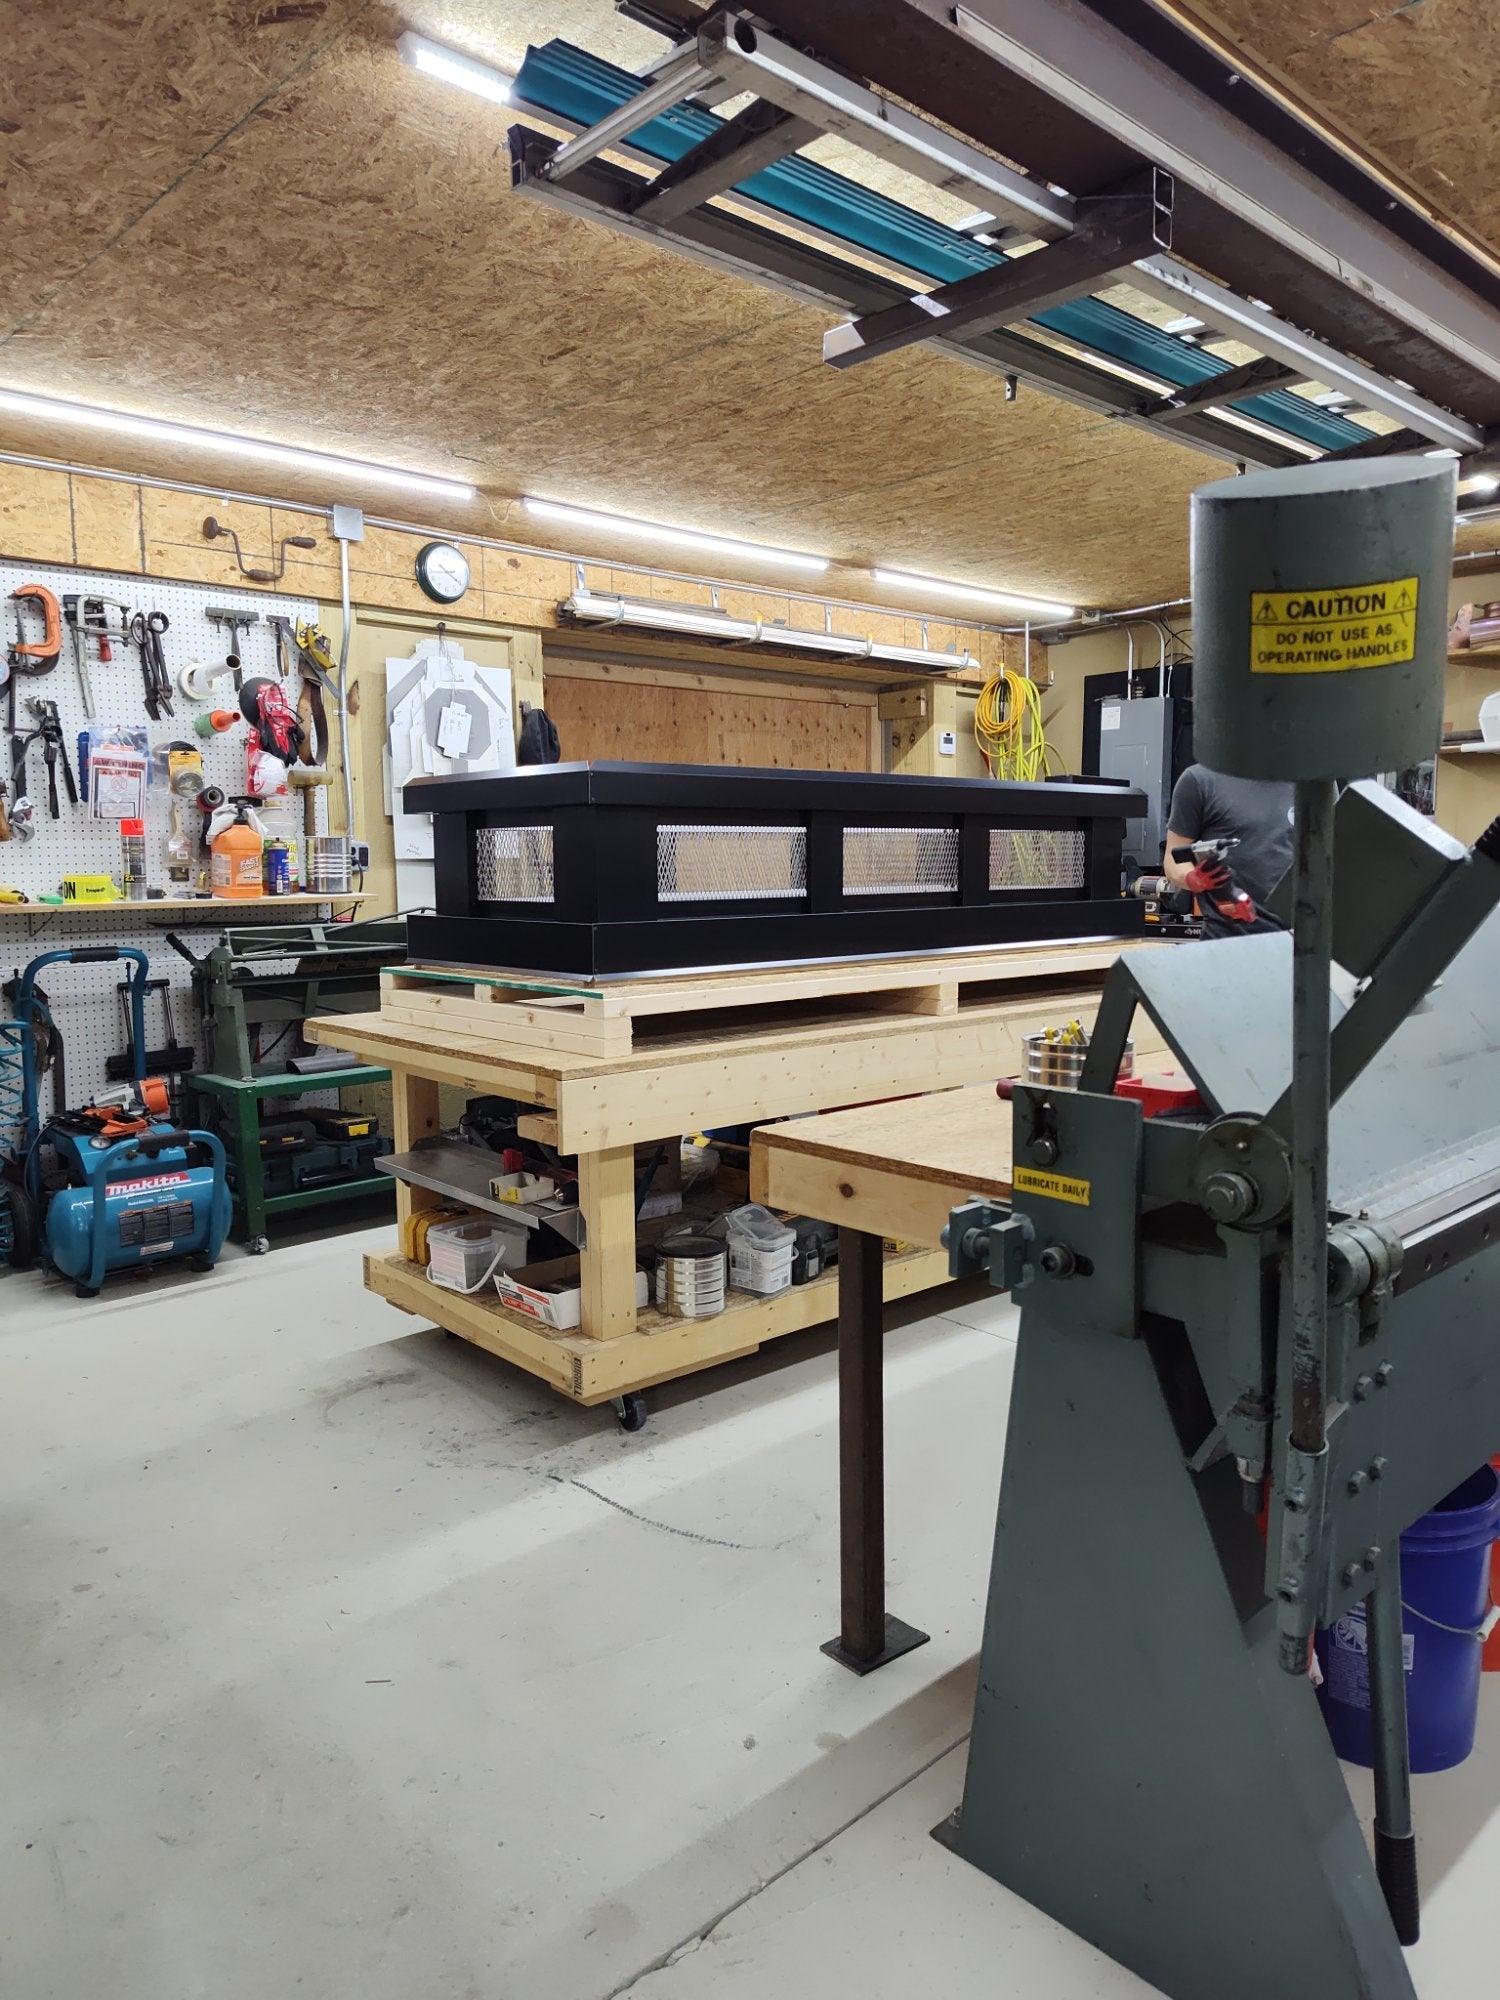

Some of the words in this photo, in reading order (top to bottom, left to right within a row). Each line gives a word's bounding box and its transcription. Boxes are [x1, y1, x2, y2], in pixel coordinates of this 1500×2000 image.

[1286, 592, 1386, 619] CAUTION
[1276, 632, 1297, 645] DO
[1303, 630, 1333, 644] NOT
[1341, 627, 1369, 642] USE
[1375, 623, 1393, 637] AS
[1257, 649, 1342, 664] OPERATING
[1346, 640, 1408, 661] HANDLES
[1018, 1174, 1060, 1192] LUBRICATE
[1062, 1183, 1087, 1198] DAILY
